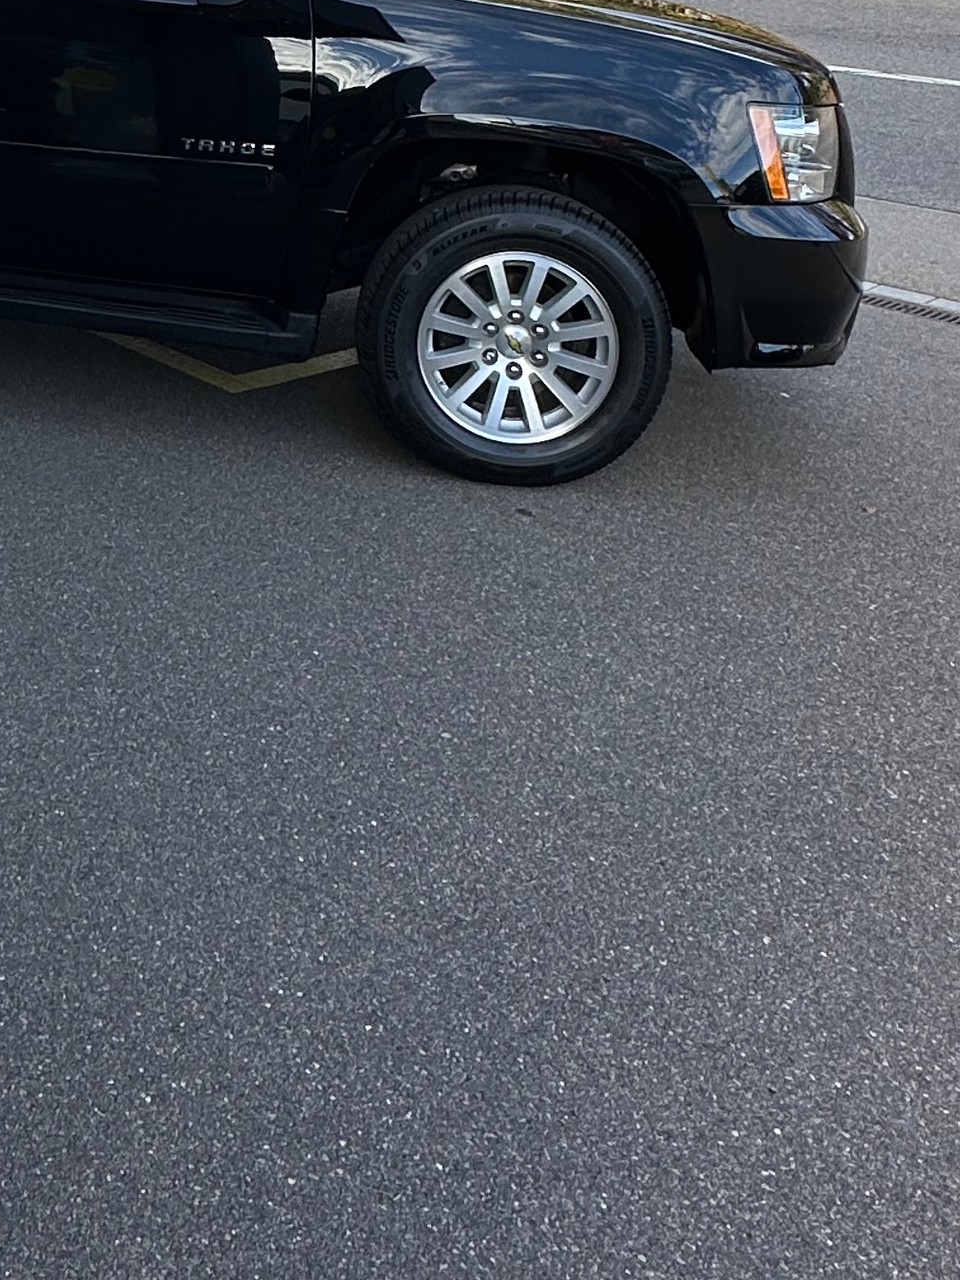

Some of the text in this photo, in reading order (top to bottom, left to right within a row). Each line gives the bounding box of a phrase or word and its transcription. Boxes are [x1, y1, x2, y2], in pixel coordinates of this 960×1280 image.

[181, 137, 276, 157] TAHOE
[432, 224, 489, 257] BLIZZAK
[383, 285, 409, 381] BRIDGESTONE
